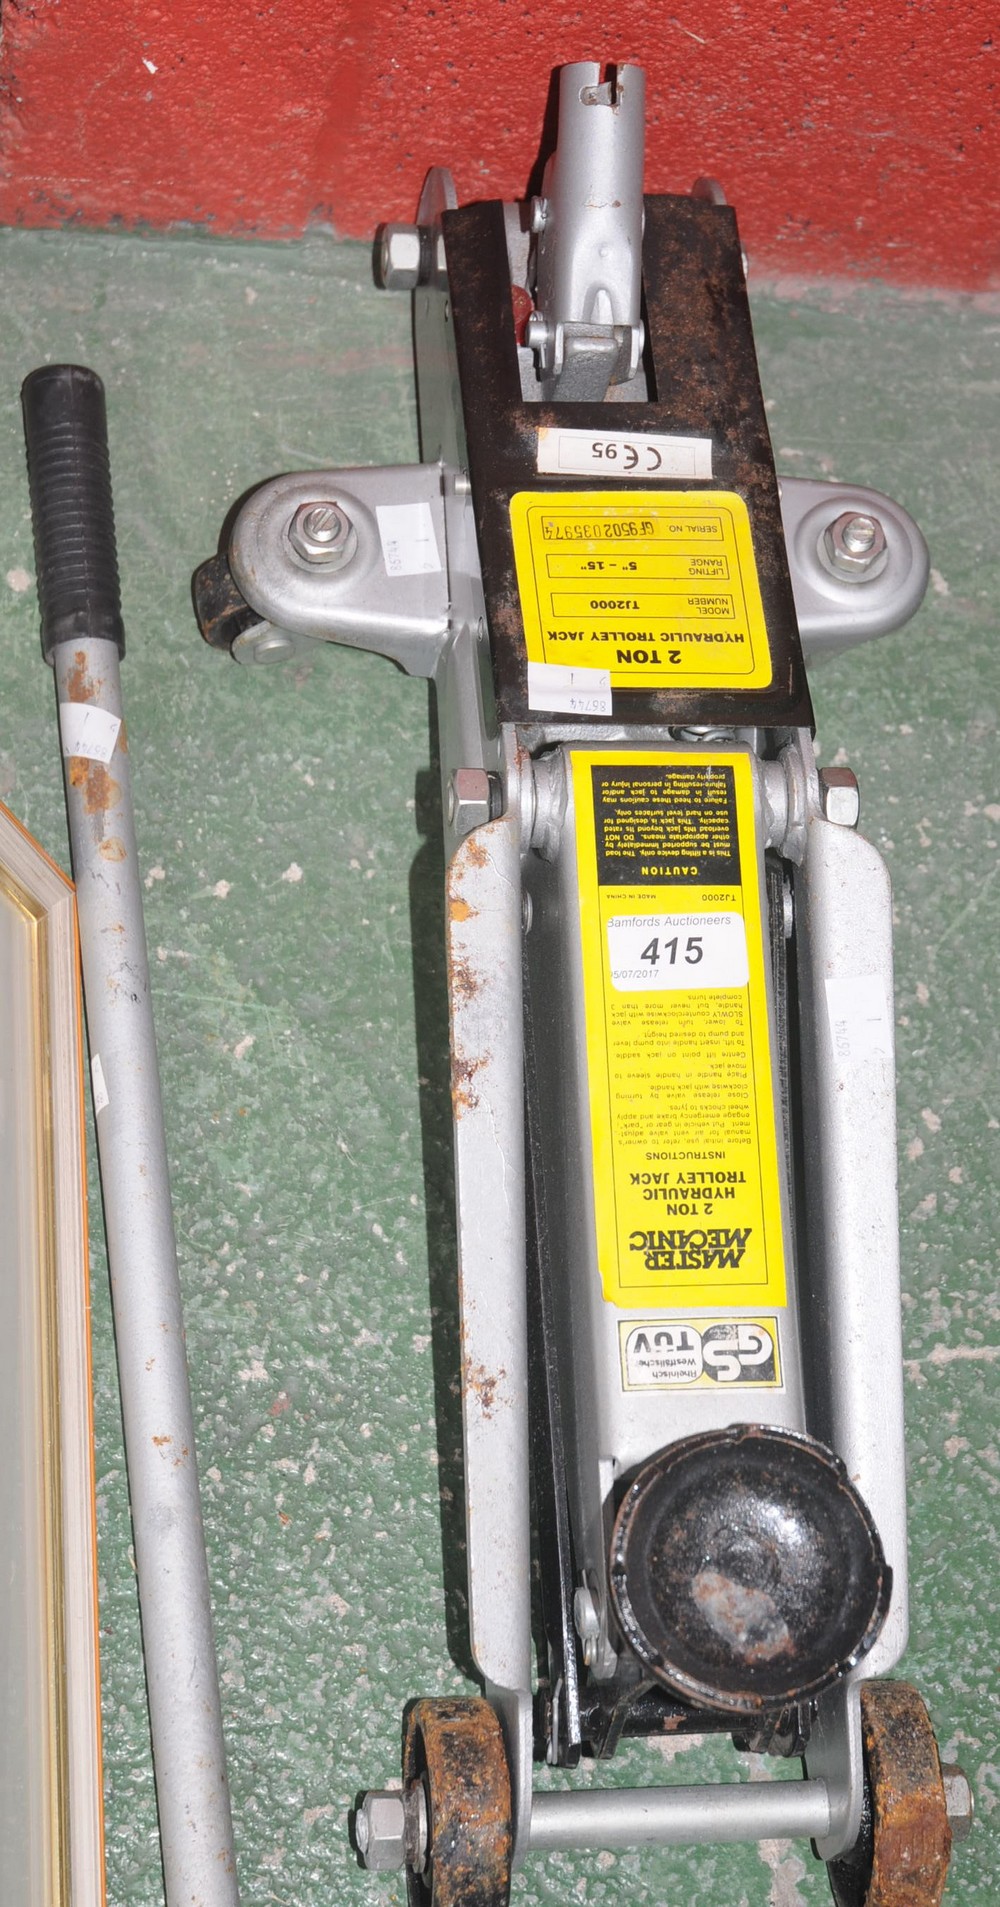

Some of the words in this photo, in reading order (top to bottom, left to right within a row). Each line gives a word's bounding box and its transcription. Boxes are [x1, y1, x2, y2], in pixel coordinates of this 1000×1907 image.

[592, 443, 617, 459] 95
[686, 525, 717, 533] SERIAL
[590, 601, 639, 609] TJ2000
[688, 597, 728, 605] NUMBER
[696, 607, 730, 615] MODEL
[547, 631, 584, 640] JACK
[591, 632, 655, 641] TROLLEY
[661, 632, 744, 642] HYDRAULIC
[616, 649, 661, 663] TON
[669, 650, 681, 664] 2
[570, 698, 606, 712] 86744
[616, 817, 648, 825] designed
[660, 817, 675, 825] jack
[698, 817, 729, 825] capacity.
[639, 849, 655, 857] only.
[641, 867, 697, 875] CAUTION
[664, 916, 731, 926] Auctioneers
[640, 937, 703, 965] 415
[611, 1011, 627, 1019] jack
[646, 1052, 661, 1060] jack
[682, 1051, 700, 1059] point
[677, 1083, 692, 1091] jack
[615, 1092, 643, 1100] turning
[617, 1113, 637, 1121] apply
[646, 1152, 725, 1160] INSTRUCTIONS
[630, 1173, 669, 1185] JACK
[676, 1171, 746, 1184] TROLLEY
[643, 1187, 735, 1200] HYDRAULIC
[667, 1204, 698, 1215] TON
[704, 1203, 713, 1214] 2
[629, 1228, 752, 1251] MECANIC
[644, 1249, 745, 1270] MASTER
[633, 1331, 694, 1353] TÜV
[652, 1370, 697, 1378] Rheinisch
